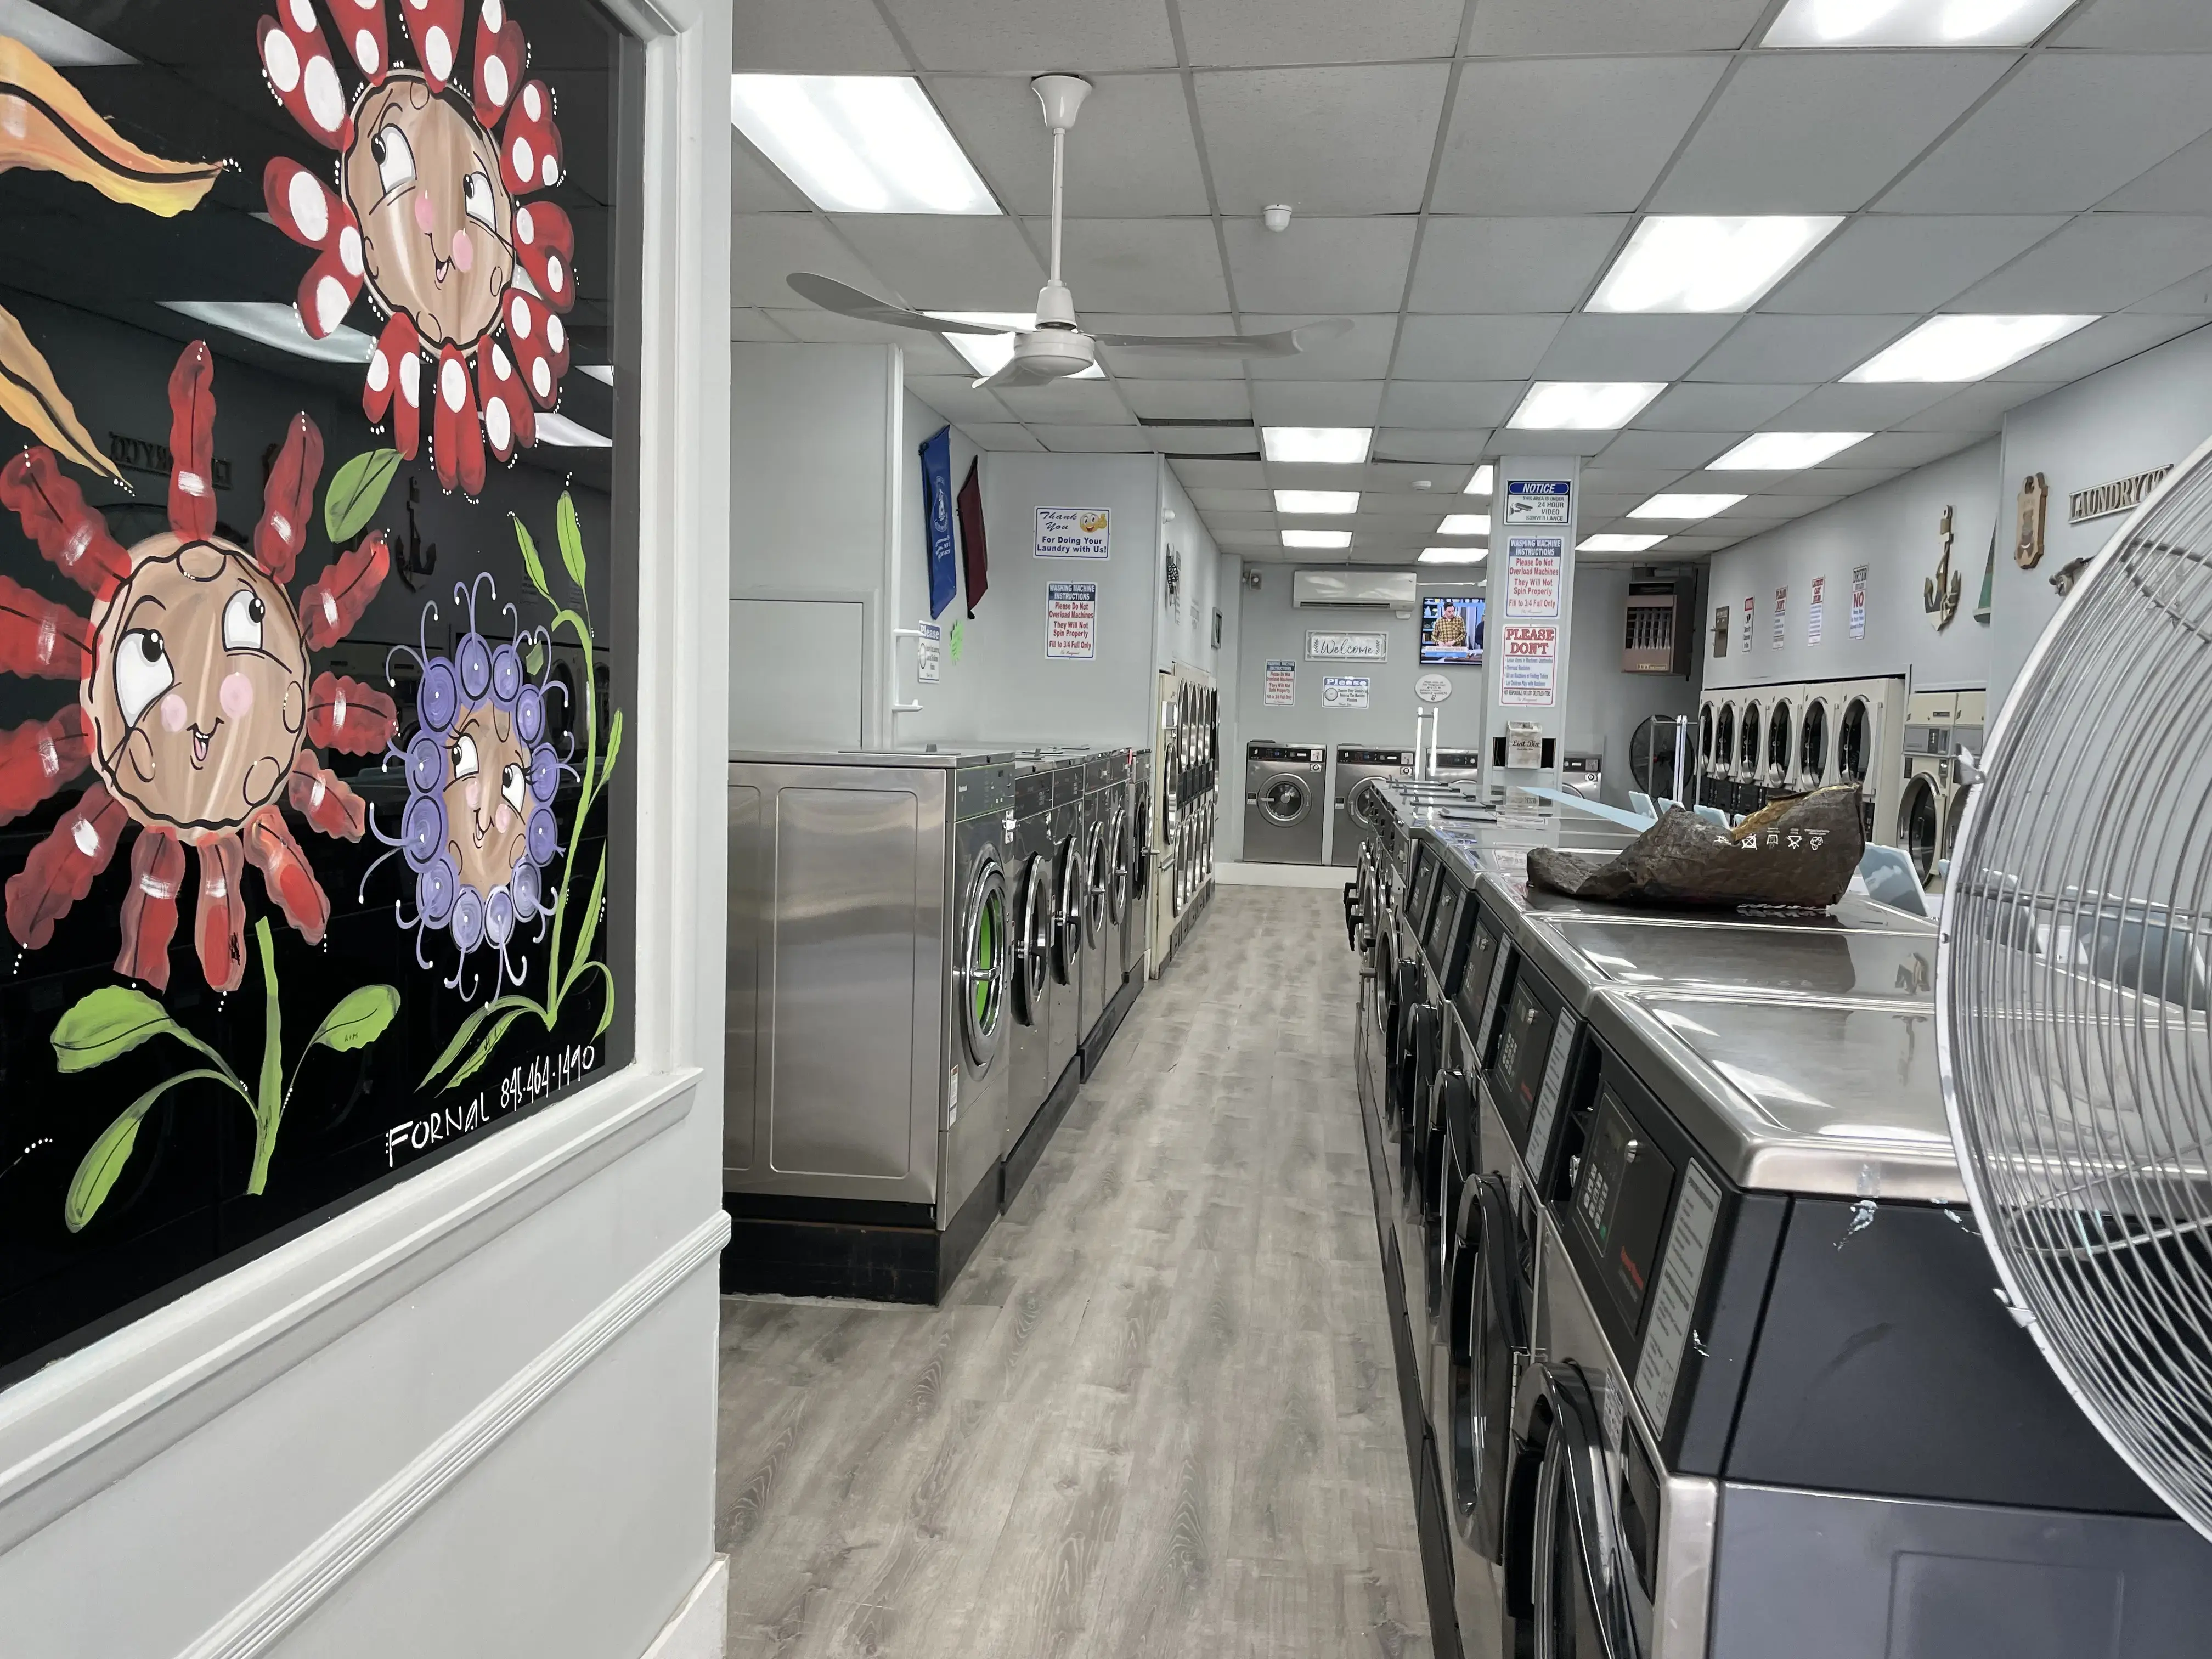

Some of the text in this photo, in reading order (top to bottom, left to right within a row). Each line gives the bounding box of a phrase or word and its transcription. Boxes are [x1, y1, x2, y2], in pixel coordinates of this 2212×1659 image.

[1522, 483, 1556, 493] NOTICE
[2069, 475, 2145, 521] LAUNDRY
[1040, 511, 1077, 520] Thank
[1046, 522, 1069, 531] You
[1058, 537, 1081, 545] Doing
[1037, 544, 1070, 553] Laundry
[1510, 567, 1532, 575] Overload
[1514, 578, 1528, 587] They
[1514, 587, 1553, 596] Spin Properly
[1544, 600, 1555, 608] Only
[1854, 591, 1864, 608] NO
[1054, 621, 1066, 629] They
[920, 625, 939, 639] Please
[1053, 629, 1088, 639] Spin Properly
[1506, 629, 1554, 641] PLEASE
[1081, 642, 1091, 650] Only
[1321, 639, 1373, 654] Welcome
[1510, 642, 1549, 654] DON'T
